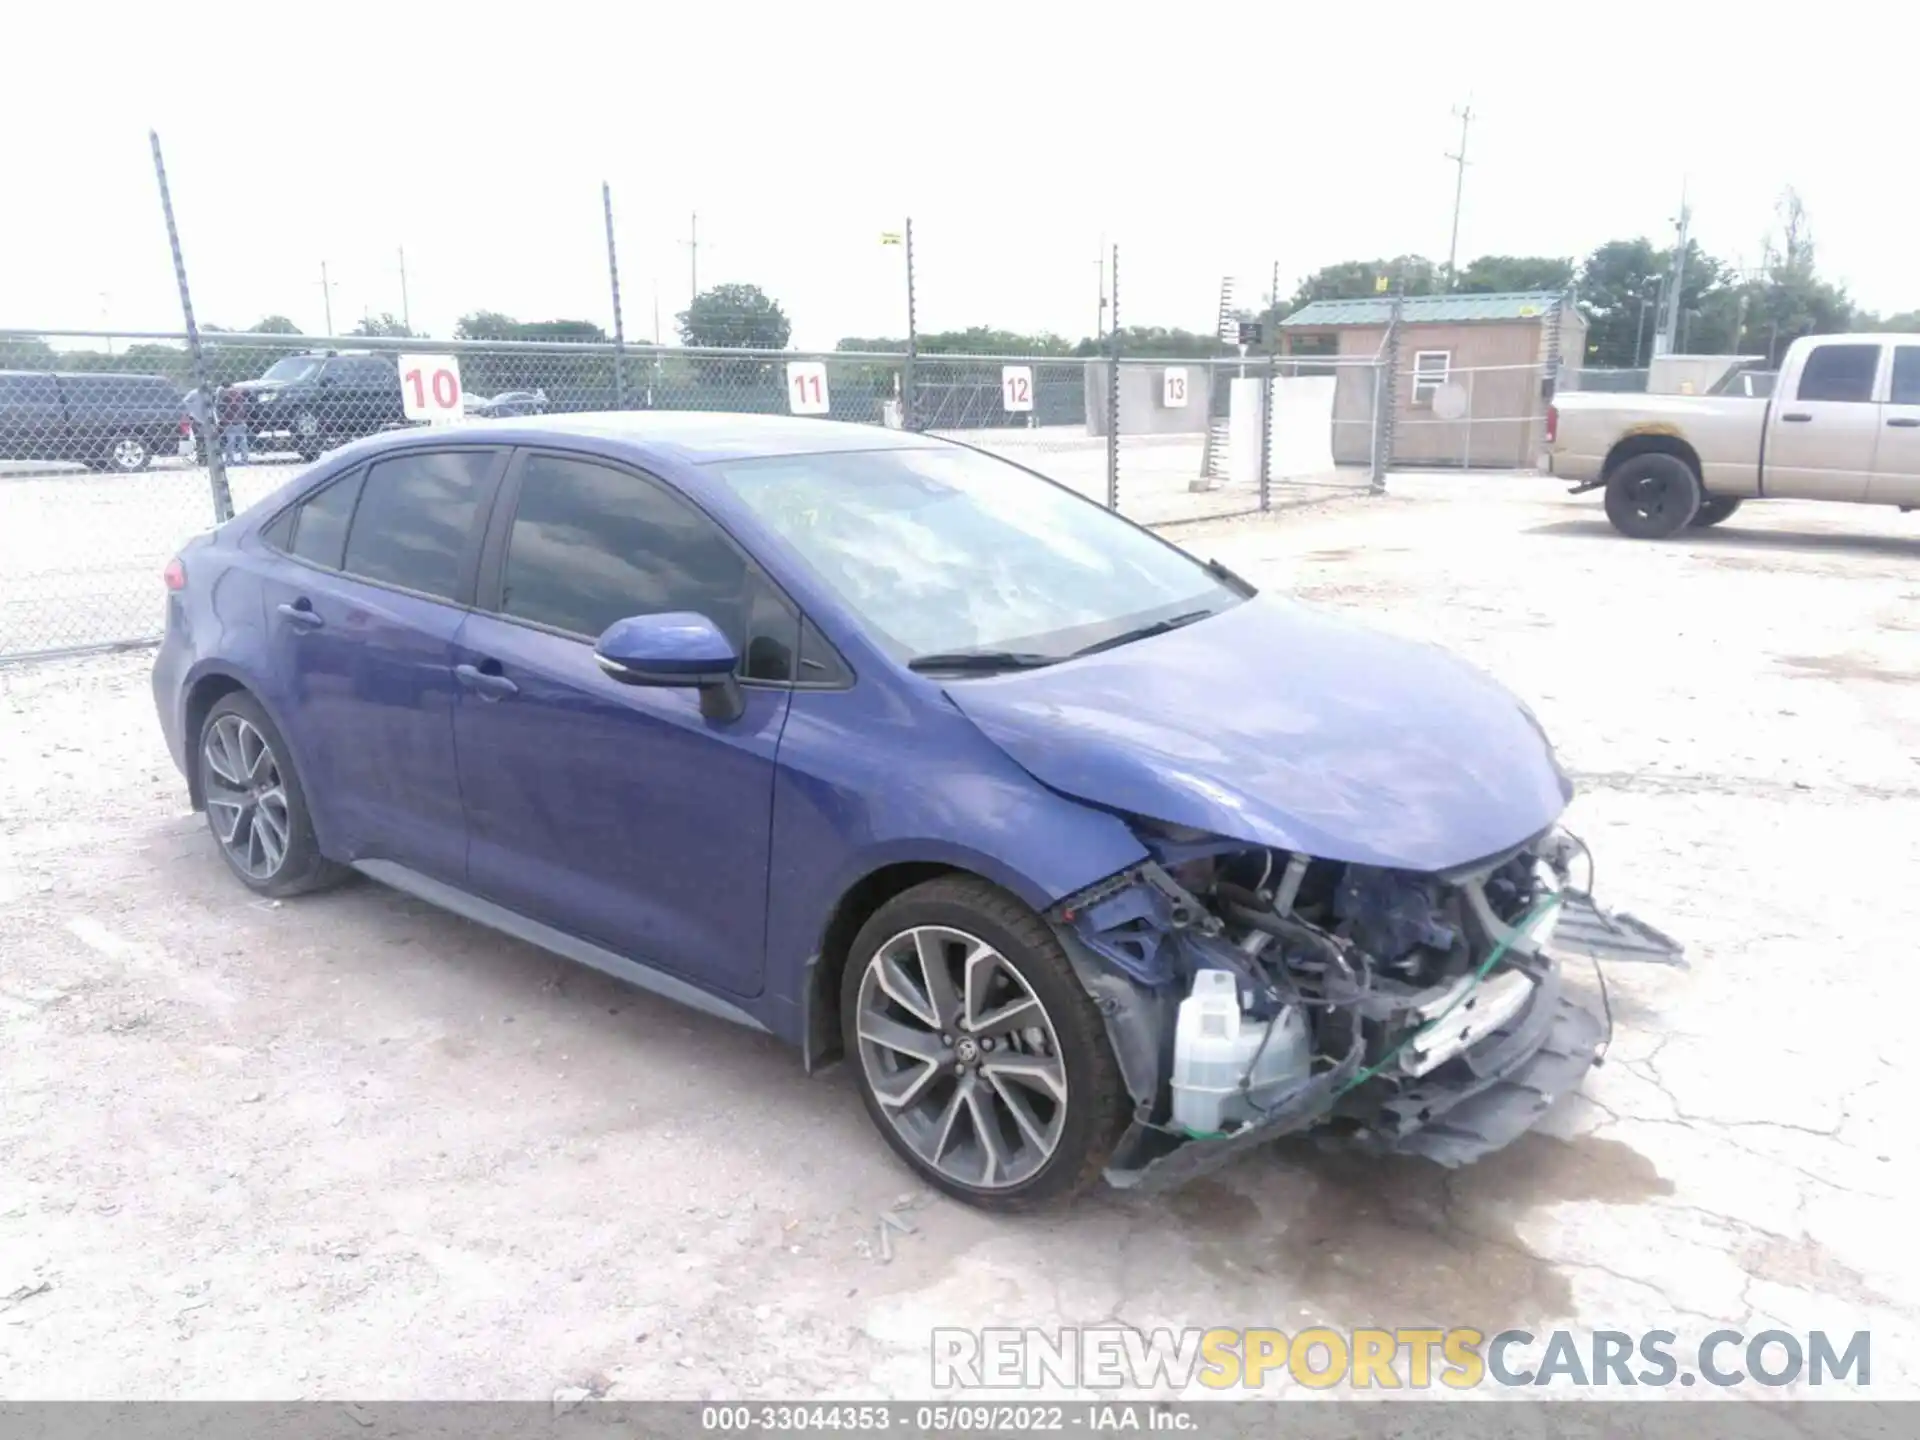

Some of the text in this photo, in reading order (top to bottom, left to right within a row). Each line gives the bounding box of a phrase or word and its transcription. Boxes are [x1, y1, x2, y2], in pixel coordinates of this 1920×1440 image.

[405, 368, 458, 408] 10
[794, 375, 821, 404] 11
[1007, 377, 1029, 403] 12
[1168, 377, 1185, 400] 13
